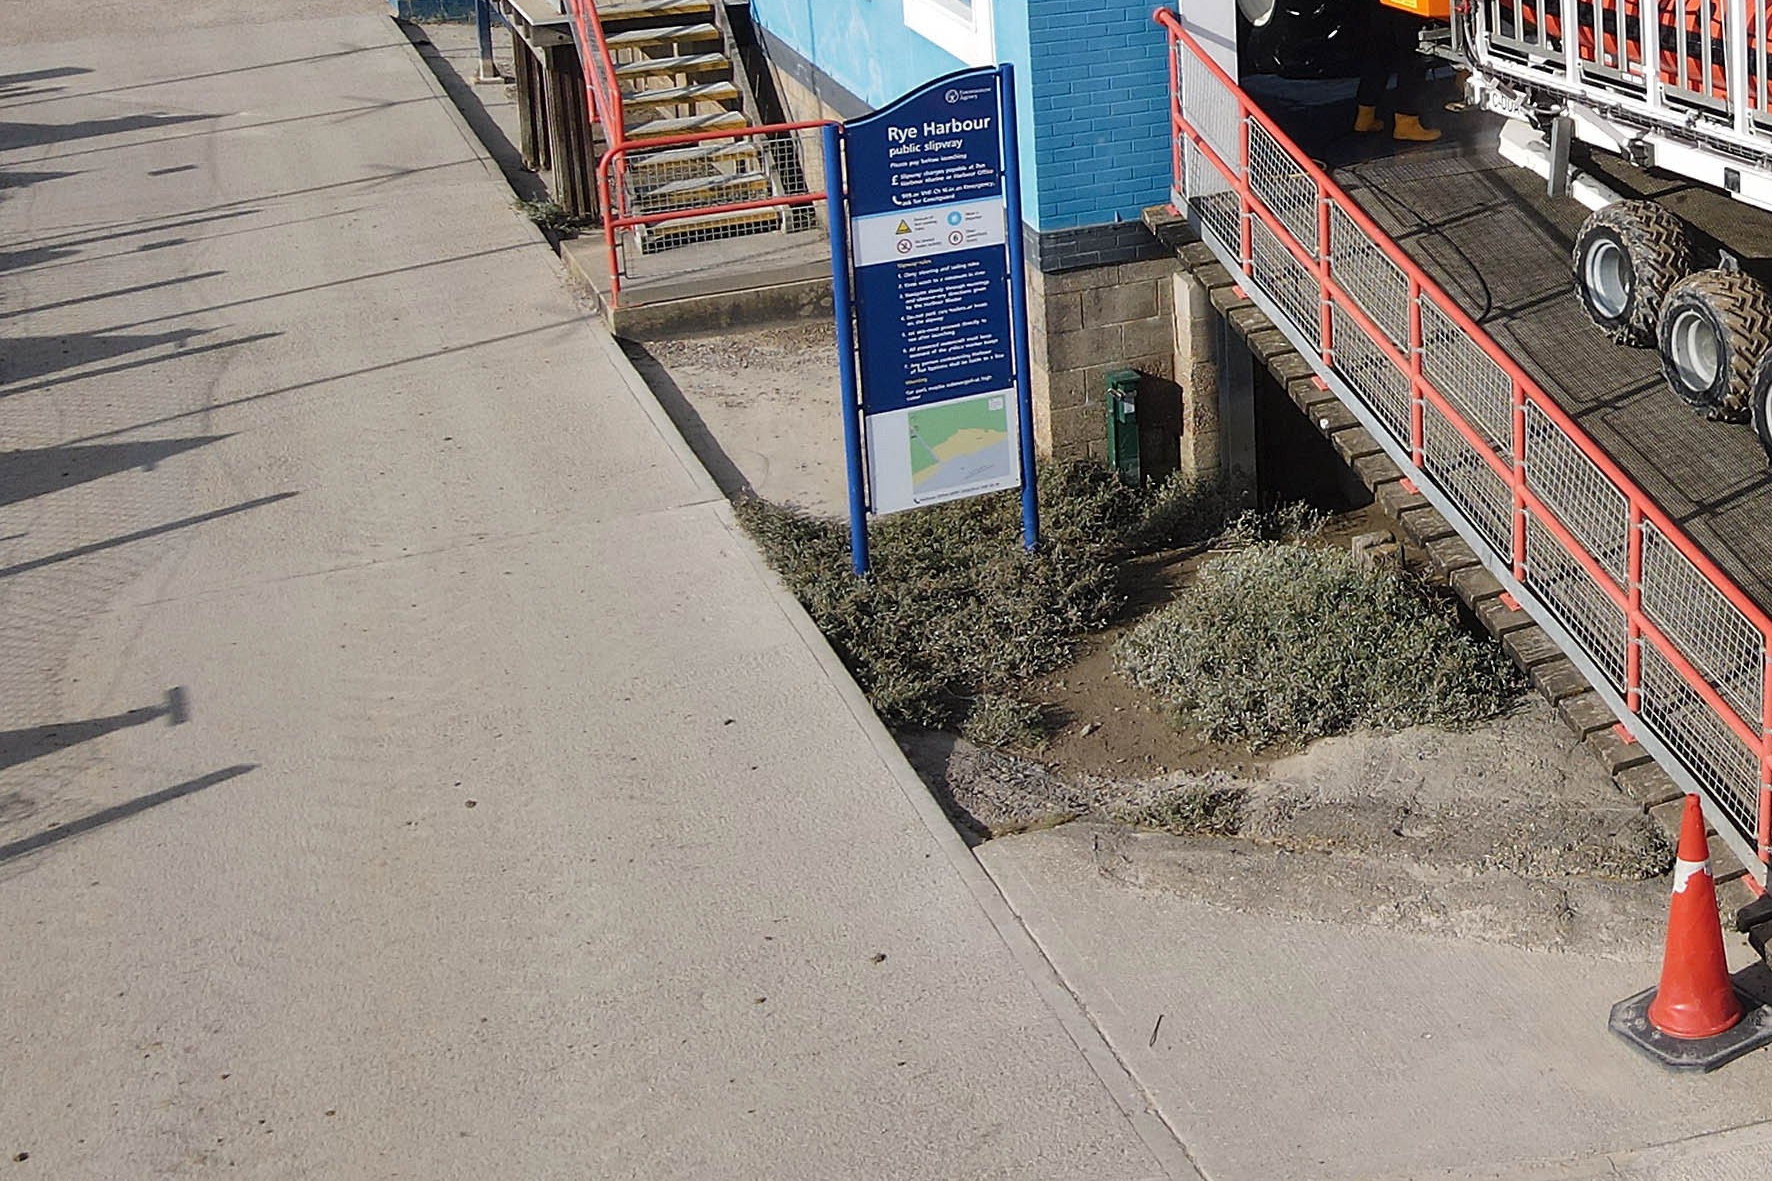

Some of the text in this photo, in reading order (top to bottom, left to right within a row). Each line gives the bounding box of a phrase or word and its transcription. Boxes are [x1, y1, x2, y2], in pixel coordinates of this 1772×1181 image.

[887, 117, 991, 143] Rye Harbour
[889, 139, 963, 158] public slipway
[891, 174, 899, 186] £
